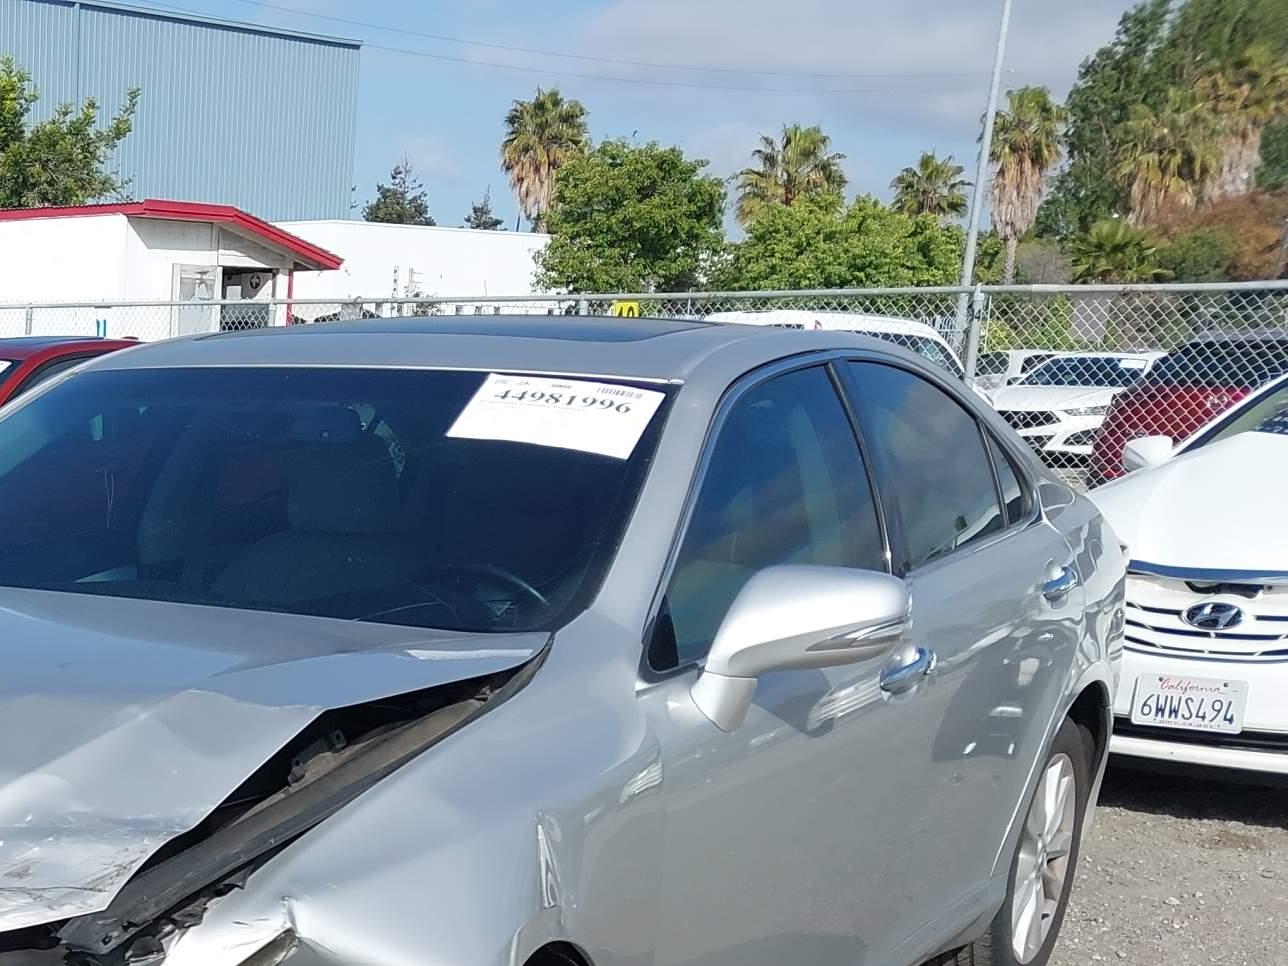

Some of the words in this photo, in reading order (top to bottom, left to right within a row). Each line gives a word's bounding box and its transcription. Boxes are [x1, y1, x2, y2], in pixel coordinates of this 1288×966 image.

[492, 389, 633, 414] 44981996
[1160, 679, 1225, 694] California
[1140, 693, 1235, 725] 6WWS494
